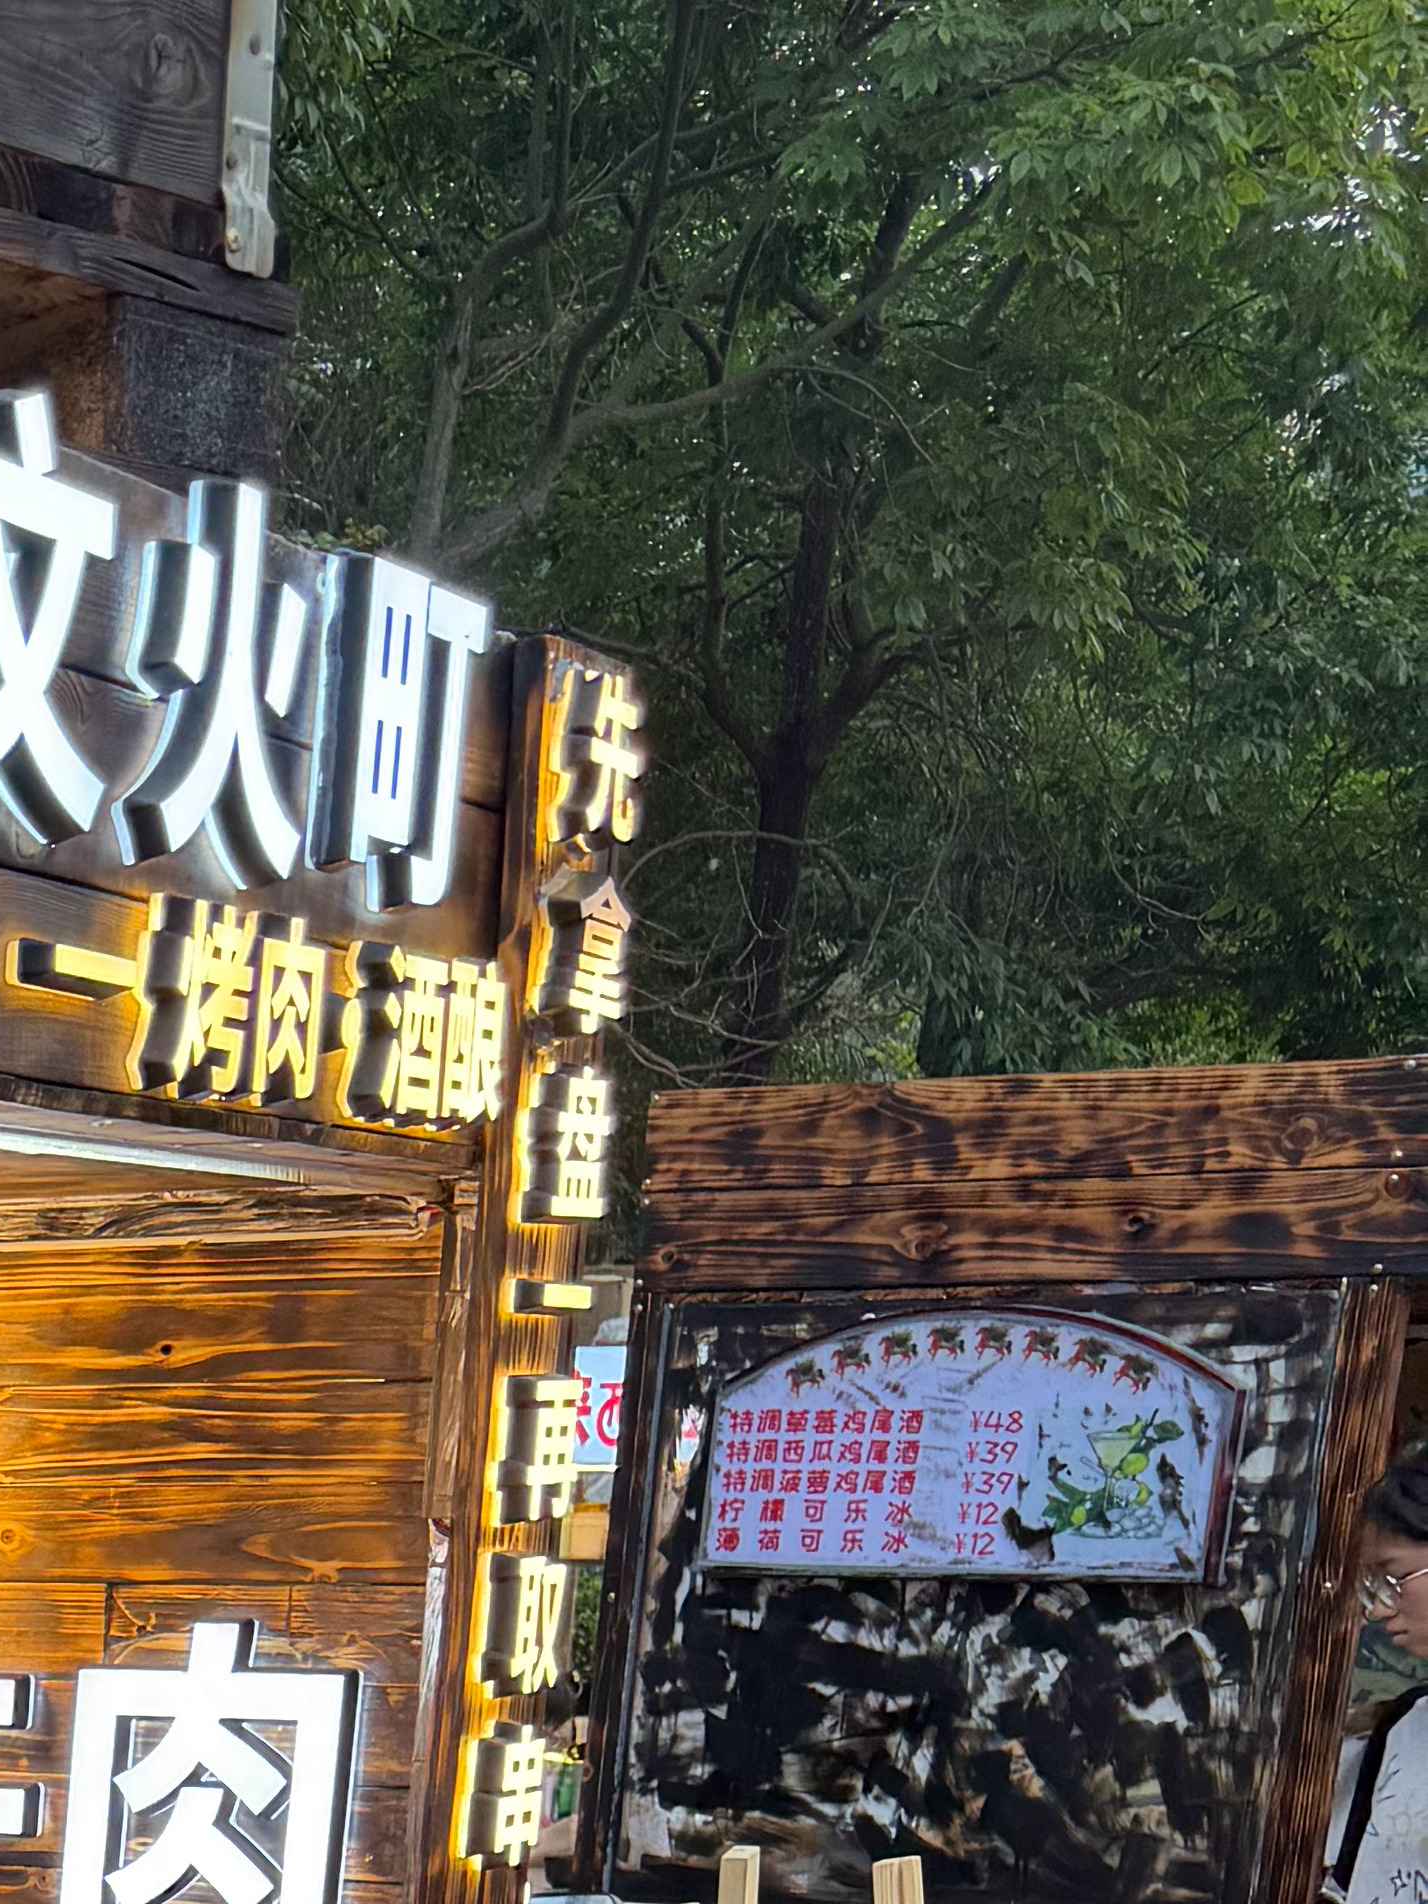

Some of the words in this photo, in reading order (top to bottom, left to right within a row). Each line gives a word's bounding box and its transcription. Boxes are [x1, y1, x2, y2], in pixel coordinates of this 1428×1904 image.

[728, 1408, 924, 1434] 特调草莓鸡尾酒
[969, 1410, 1024, 1433] ¥48
[725, 1438, 920, 1465] 特调西瓜鸡尾酒
[966, 1441, 1019, 1464] ¥39
[721, 1468, 917, 1495] 特调菠萝鸡尾酒
[961, 1471, 1014, 1495] ¥39
[957, 1502, 999, 1525] ¥12
[953, 1532, 995, 1555] ¥12
